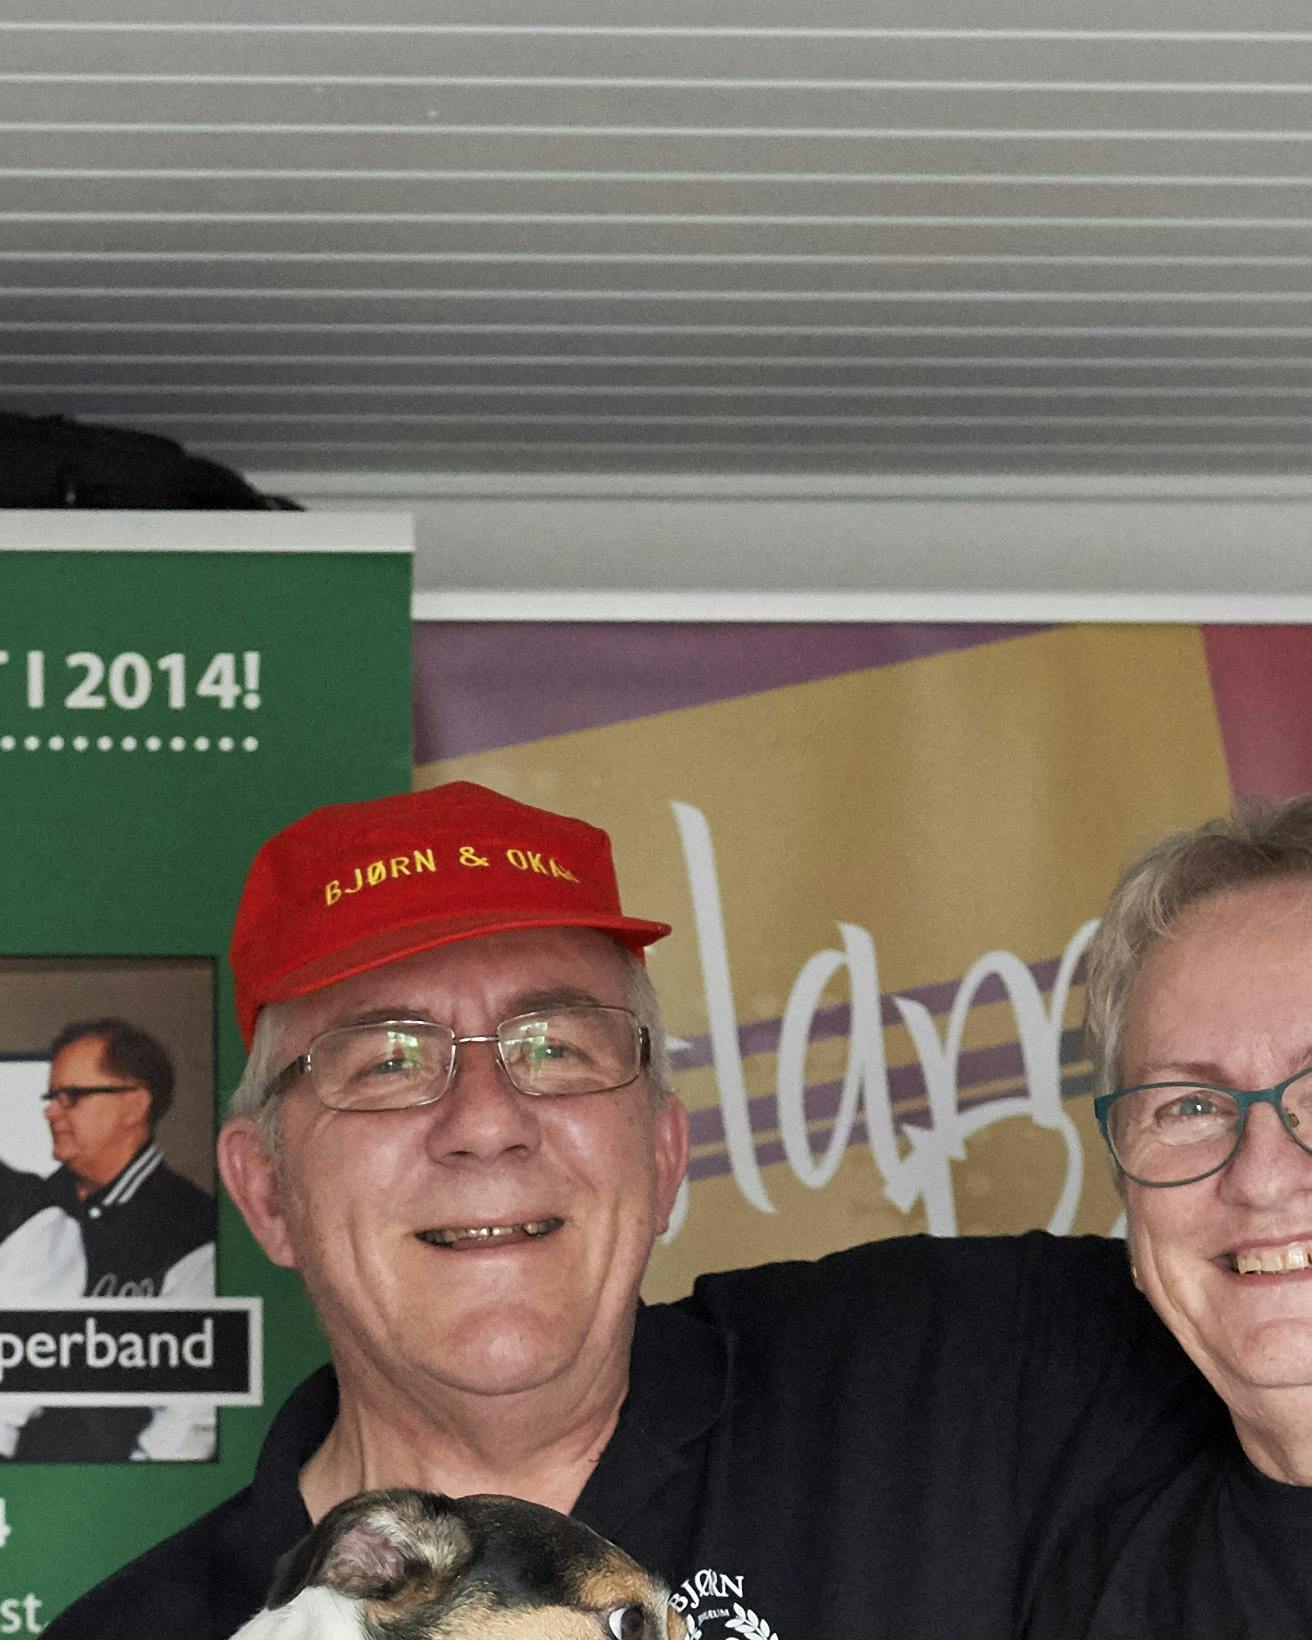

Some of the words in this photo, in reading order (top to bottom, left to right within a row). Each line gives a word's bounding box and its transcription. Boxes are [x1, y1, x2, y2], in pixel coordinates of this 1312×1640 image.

[64, 650, 262, 711] 2014!
[324, 848, 437, 906] BJØRN
[459, 846, 490, 868] &
